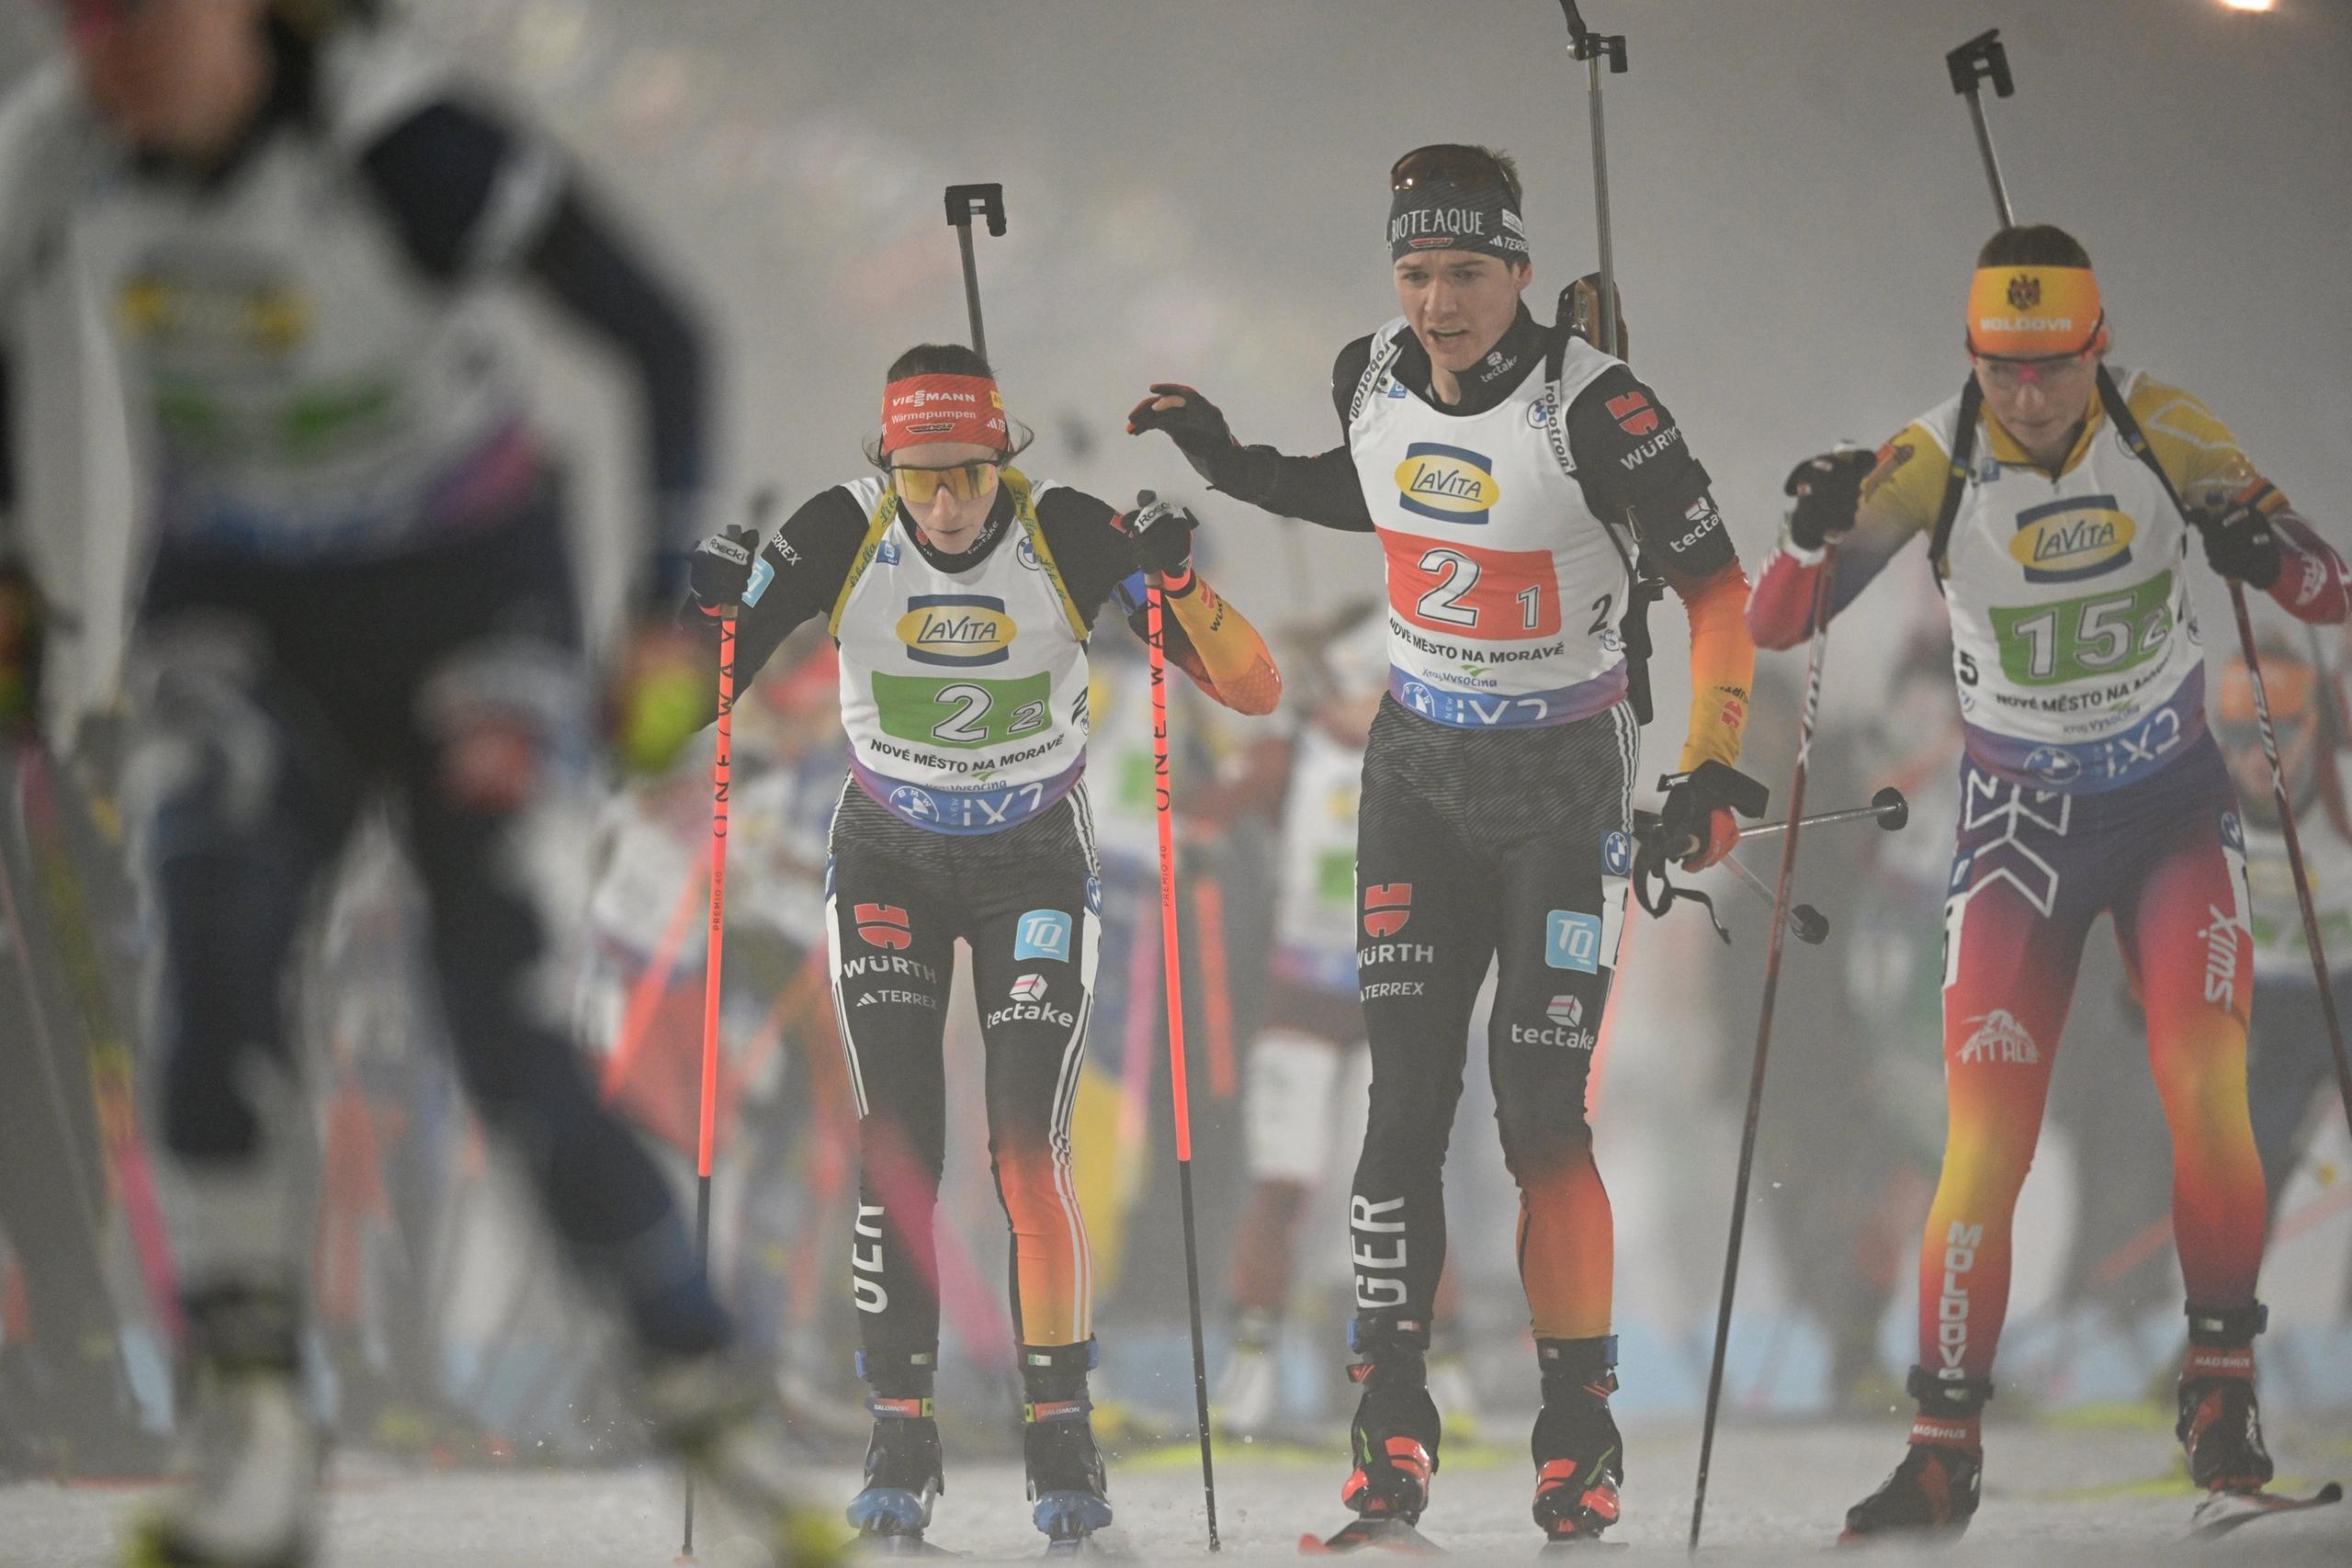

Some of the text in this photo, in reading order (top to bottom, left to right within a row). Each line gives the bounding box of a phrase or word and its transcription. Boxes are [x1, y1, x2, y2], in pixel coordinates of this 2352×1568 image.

[1391, 208, 1486, 244] BIOTEAQUE
[1503, 235, 1530, 254] TERR
[1351, 343, 1392, 420] robotron
[891, 389, 977, 408] VIESSMANN
[890, 410, 977, 424] Wärmepumpen
[1415, 548, 1543, 630] 2 1
[1588, 592, 1613, 637] 2
[2012, 593, 2137, 680] 15
[1461, 648, 1486, 663] NA
[1488, 641, 1566, 664] MORAVĚ
[932, 682, 1046, 744] 2 2
[2041, 691, 2102, 713] MĚSTO
[2107, 682, 2130, 703] NA
[870, 732, 1065, 773] NOVÉ MĚSTO NA MORAVĚ
[1024, 917, 1064, 955] TQ
[1556, 919, 1595, 966] TQ
[842, 955, 937, 985] WÜRTH
[876, 989, 938, 1011] TERREX
[1364, 982, 1425, 999] TERREX
[986, 1001, 1074, 1030] tectake
[1510, 1022, 1595, 1051] tectake
[1349, 1193, 1408, 1310] GER
[874, 1404, 910, 1413] SALOMON
